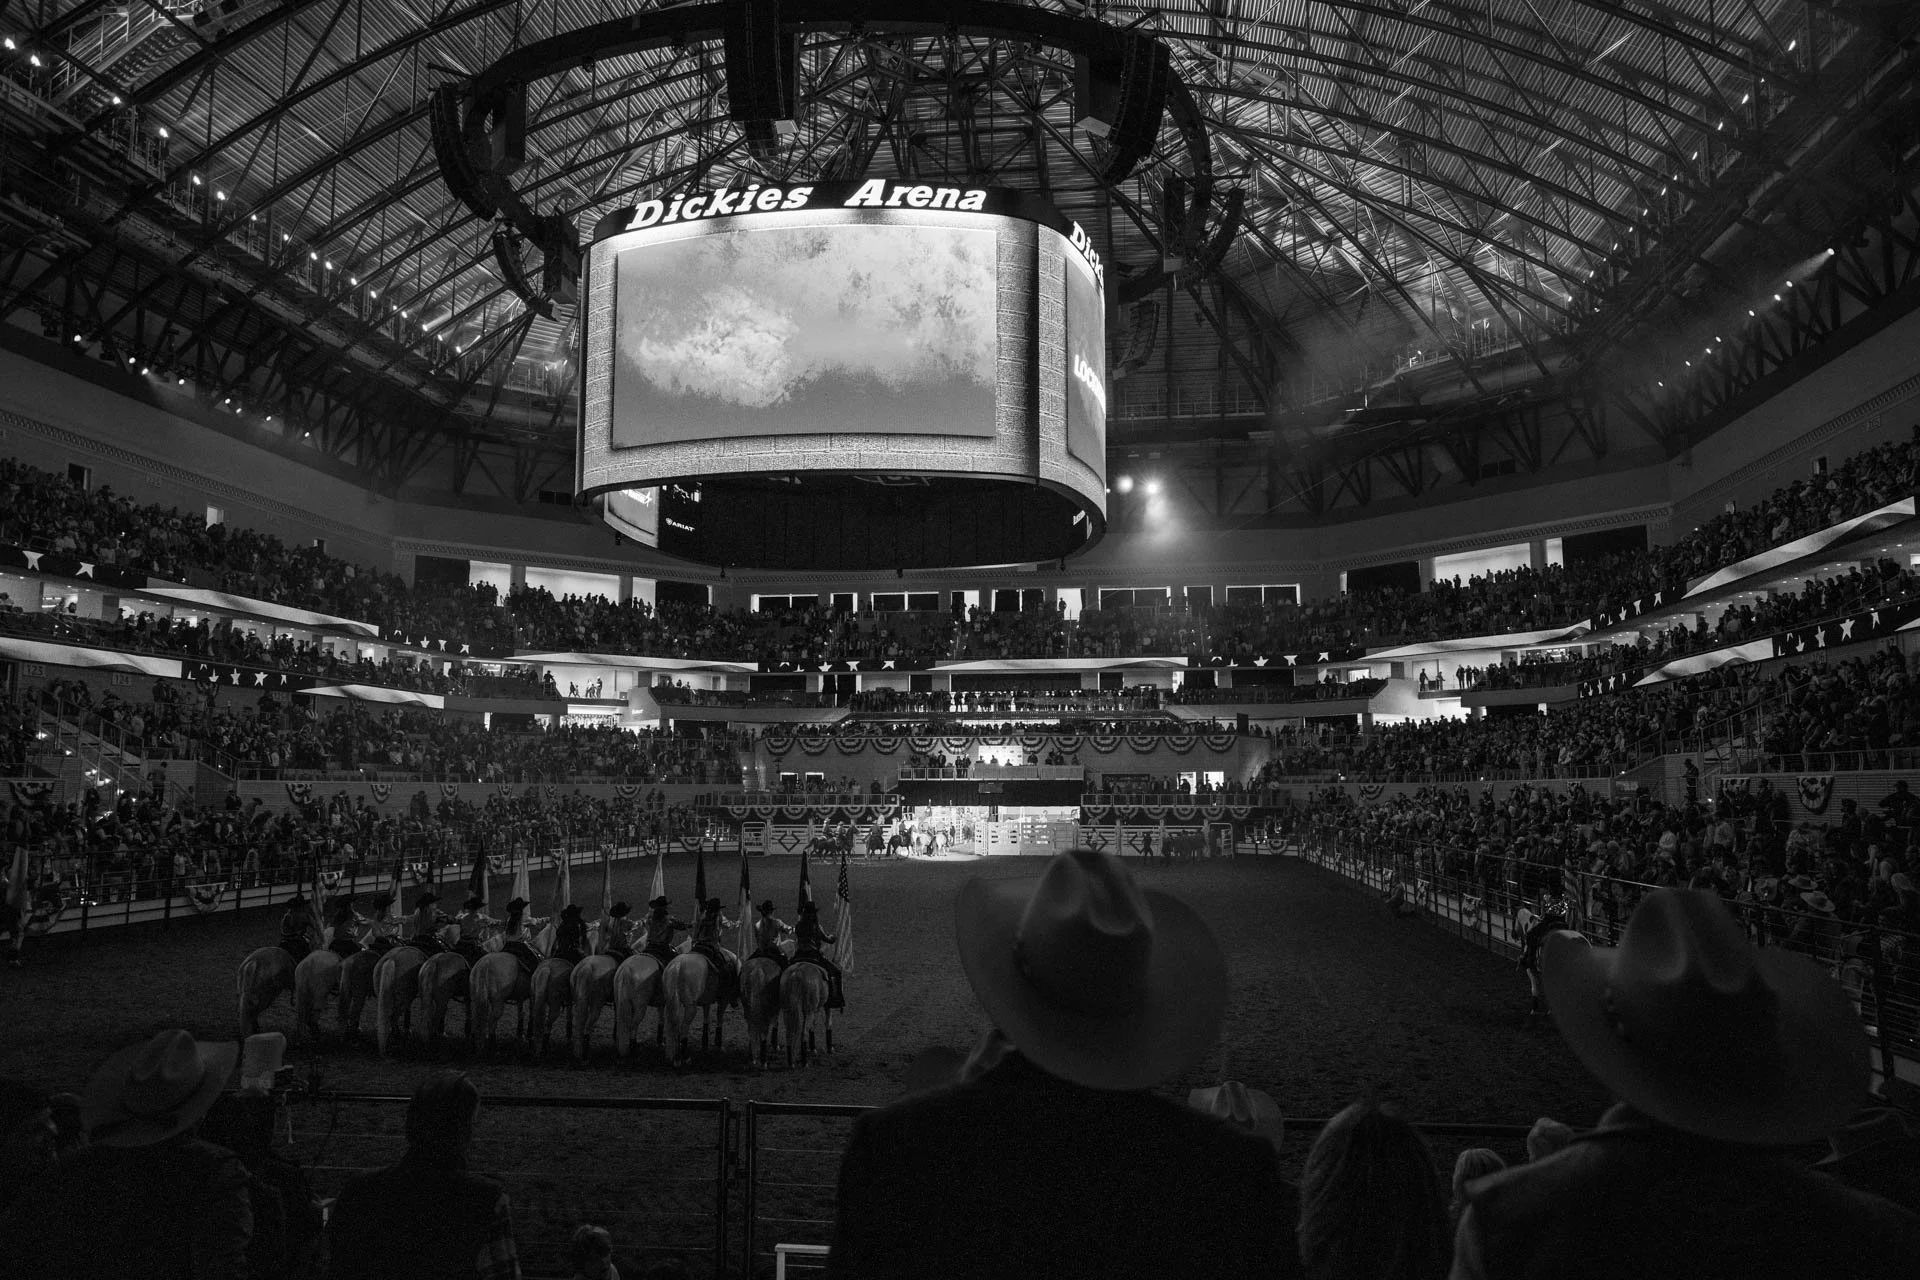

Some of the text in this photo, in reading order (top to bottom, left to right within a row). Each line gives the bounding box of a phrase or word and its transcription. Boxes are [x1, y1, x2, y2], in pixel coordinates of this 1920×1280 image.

[625, 178, 987, 231] Dickies Arena
[672, 521, 696, 532] ARIAT
